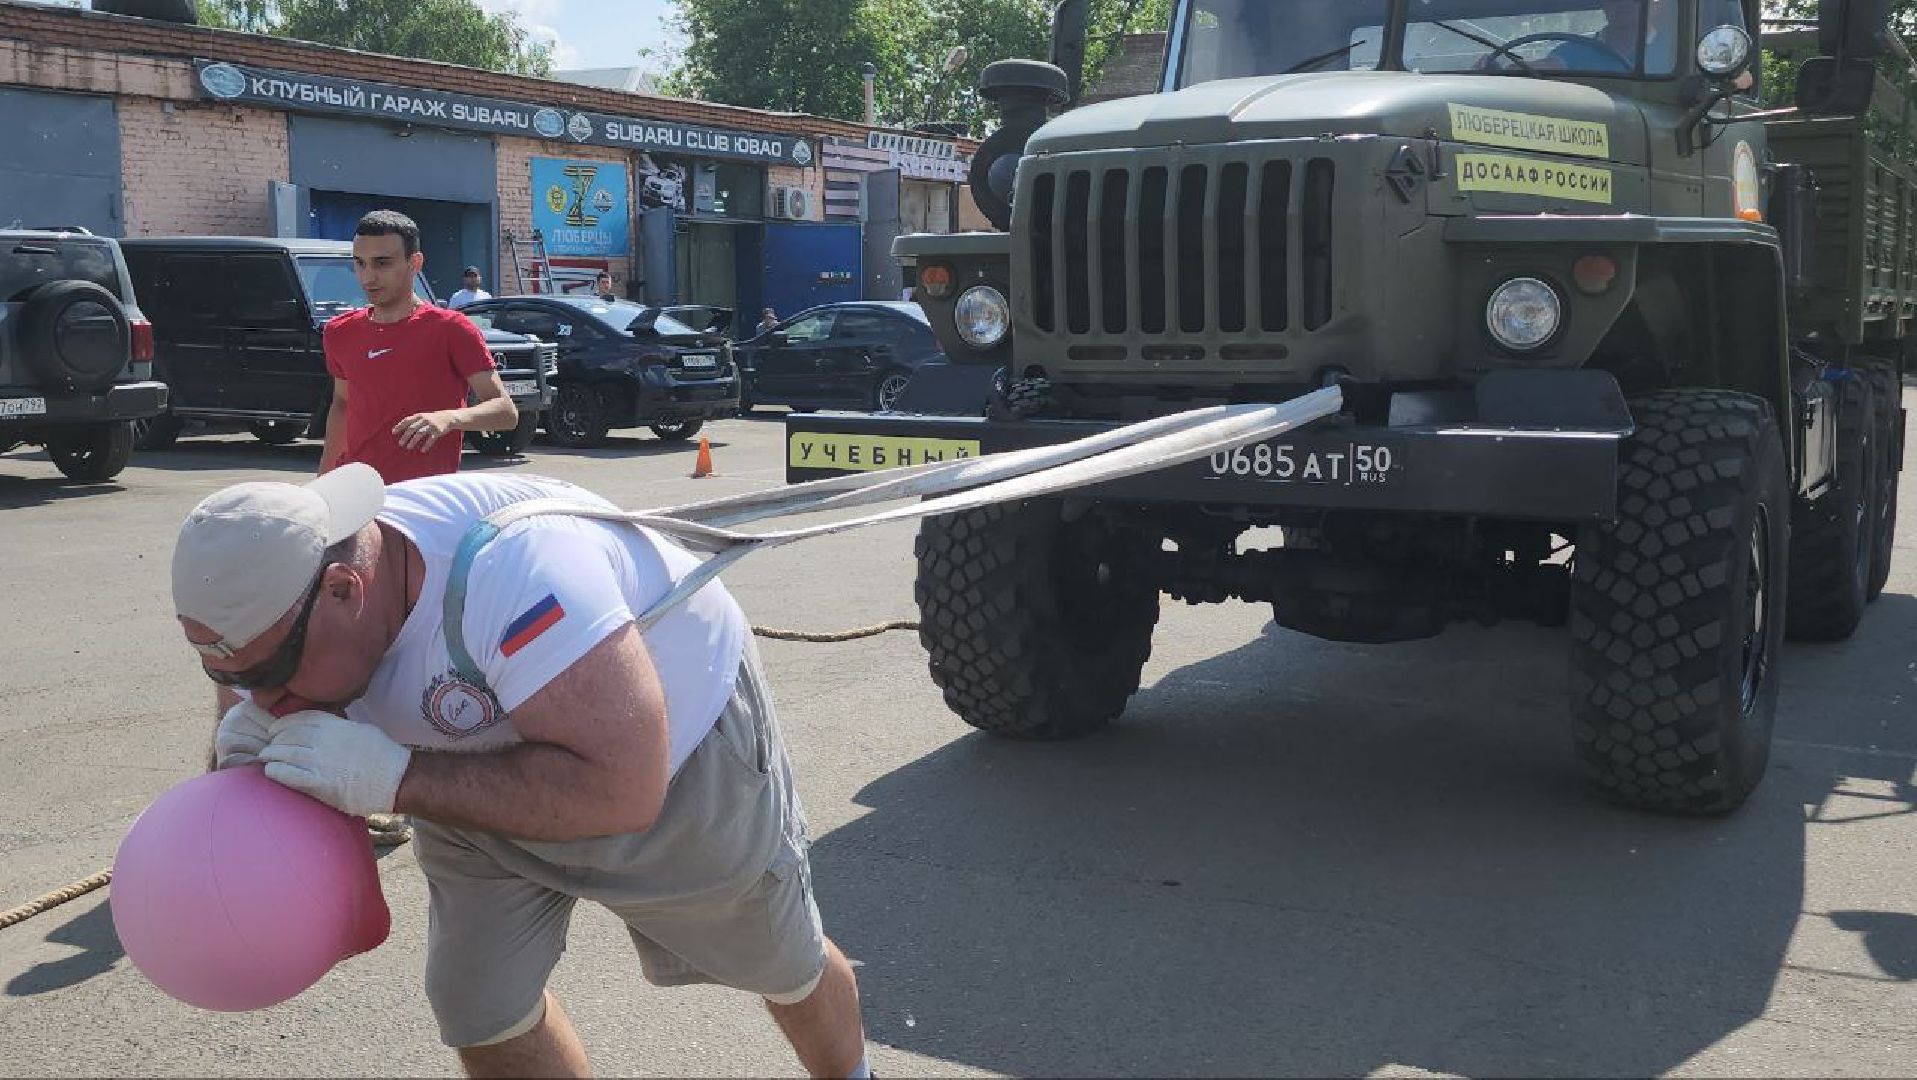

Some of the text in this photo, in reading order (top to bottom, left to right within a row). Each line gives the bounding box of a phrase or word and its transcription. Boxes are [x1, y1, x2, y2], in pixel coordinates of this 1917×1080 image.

[251, 77, 530, 129] КЛУБНЫЙ ГАРАЖ SUBARU
[605, 121, 782, 157] SUBARU CLUB ЮВАО
[1456, 108, 1604, 148] ЛЮБЕРЕЦКАЯ ШКОЛА
[1462, 161, 1609, 193] ДОСААФ РОССИИ
[1210, 443, 1296, 477] 0685
[1355, 445, 1392, 472] 50
[1360, 472, 1386, 483] RUS
